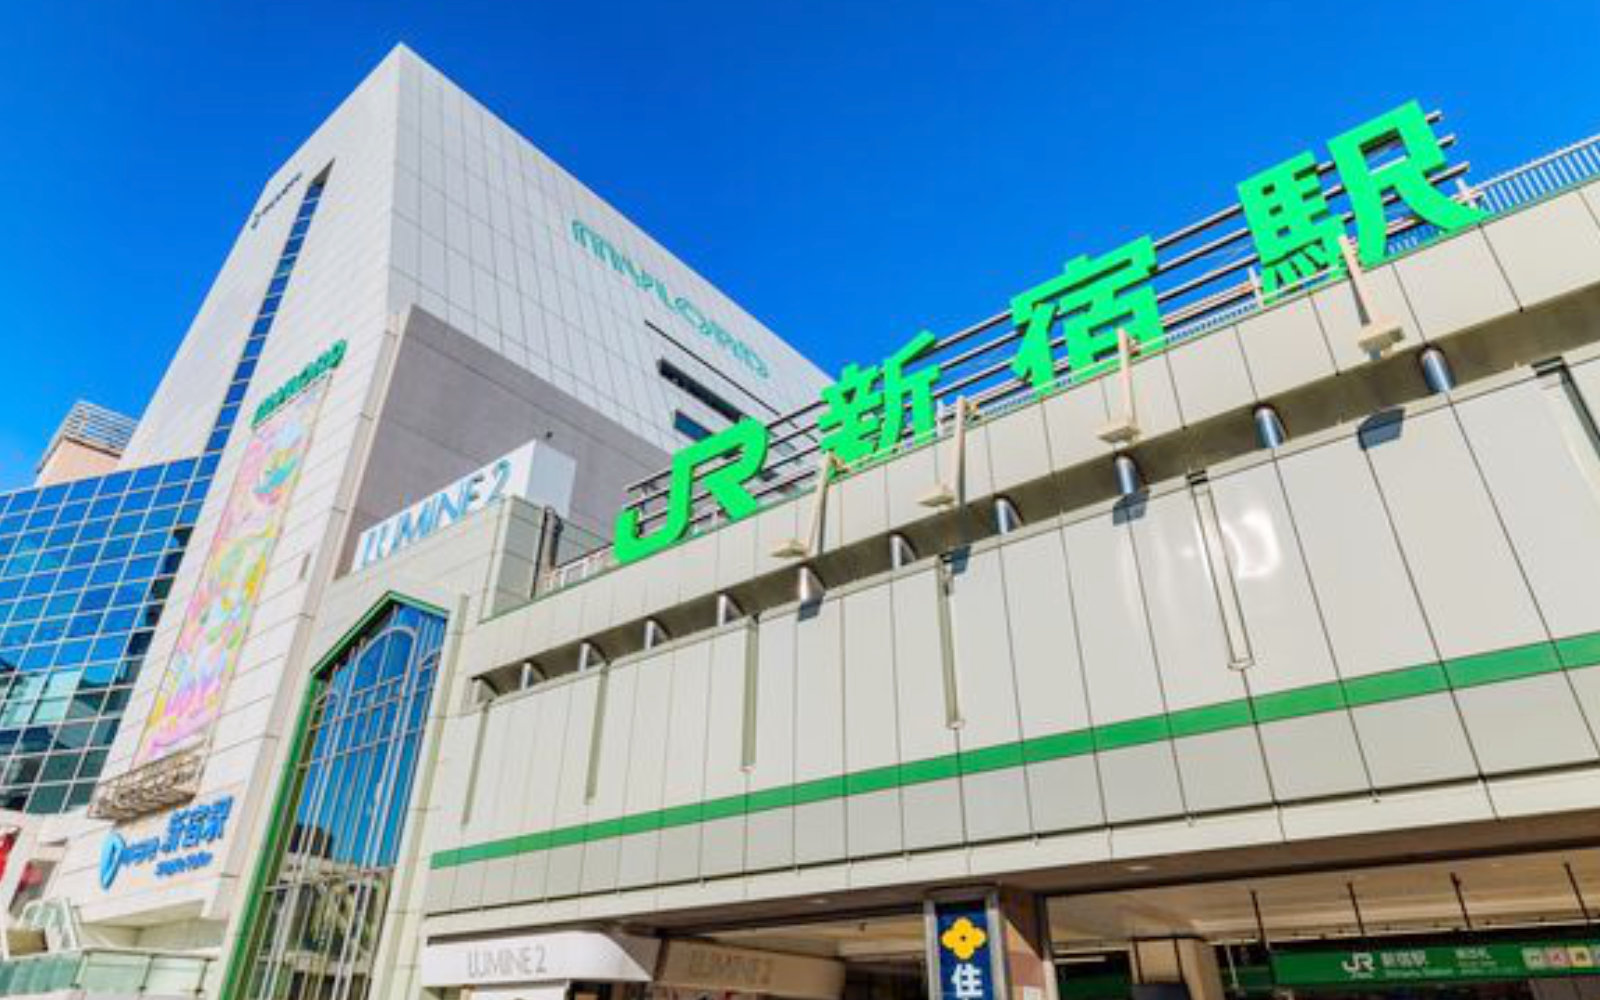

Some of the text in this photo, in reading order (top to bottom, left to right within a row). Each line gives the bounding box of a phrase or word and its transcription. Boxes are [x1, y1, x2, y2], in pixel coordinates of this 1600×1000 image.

[612, 98, 1484, 562] JR 新宿駅
[361, 458, 512, 568] LUMINE 2
[1342, 952, 1375, 972] JR
